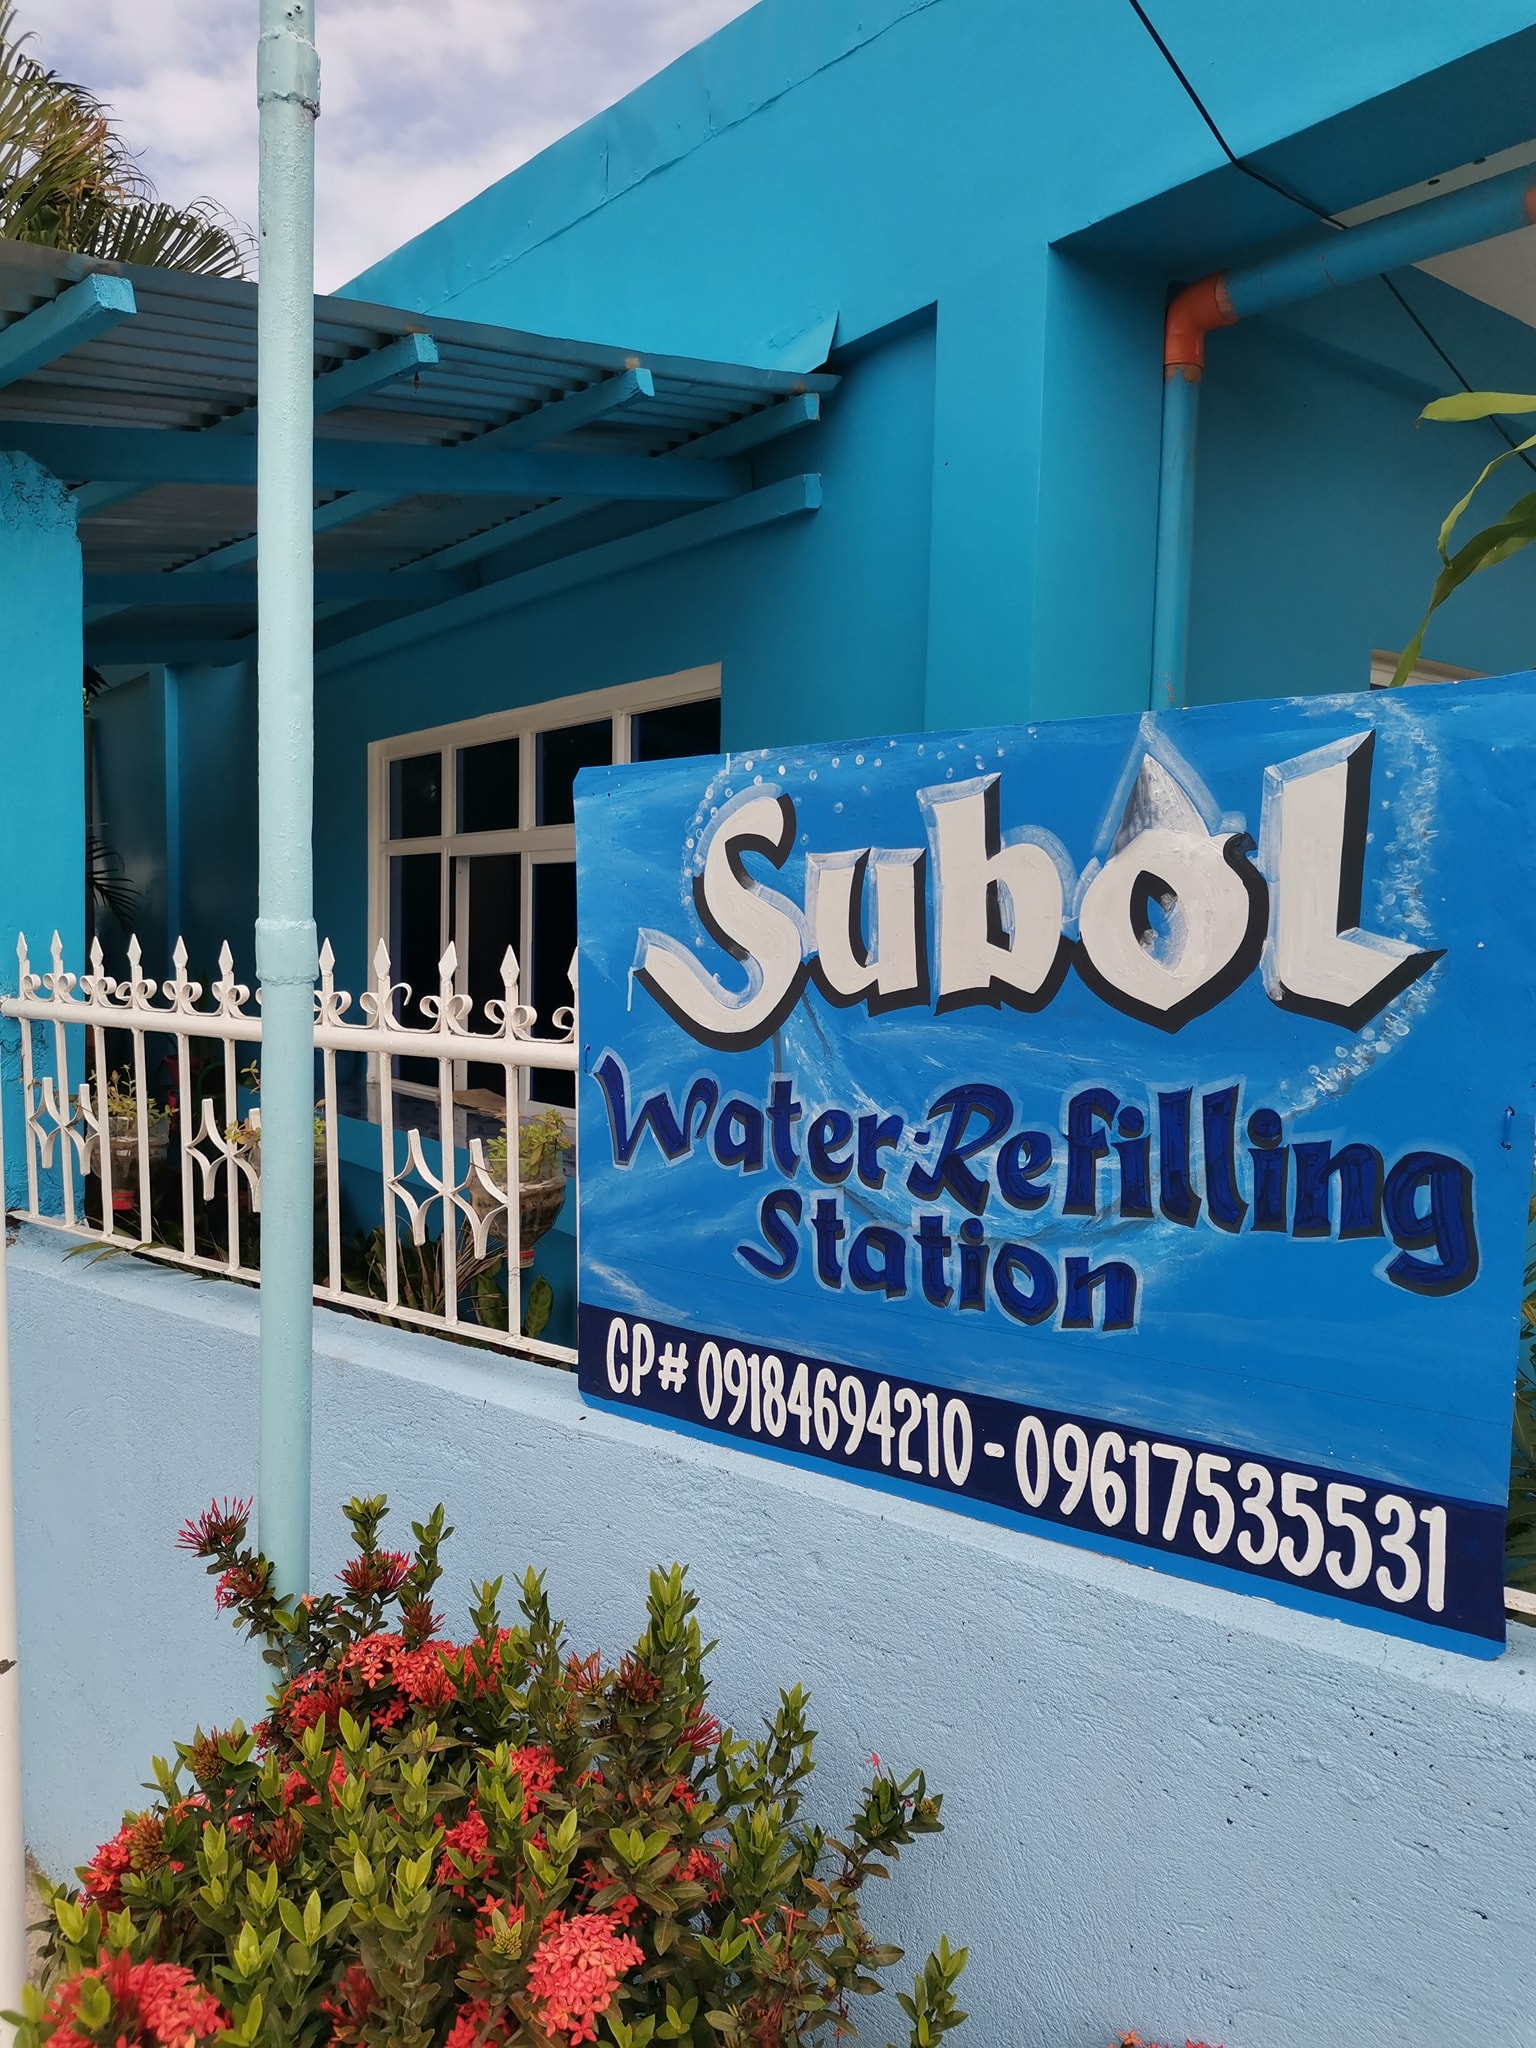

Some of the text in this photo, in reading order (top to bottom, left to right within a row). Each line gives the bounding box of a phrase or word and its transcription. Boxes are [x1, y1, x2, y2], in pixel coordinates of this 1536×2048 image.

[736, 1188, 1139, 1332] Station
[606, 1316, 689, 1395] CP#
[698, 1341, 974, 1488] 09184694210
[1015, 1415, 1447, 1612] 09617535531
